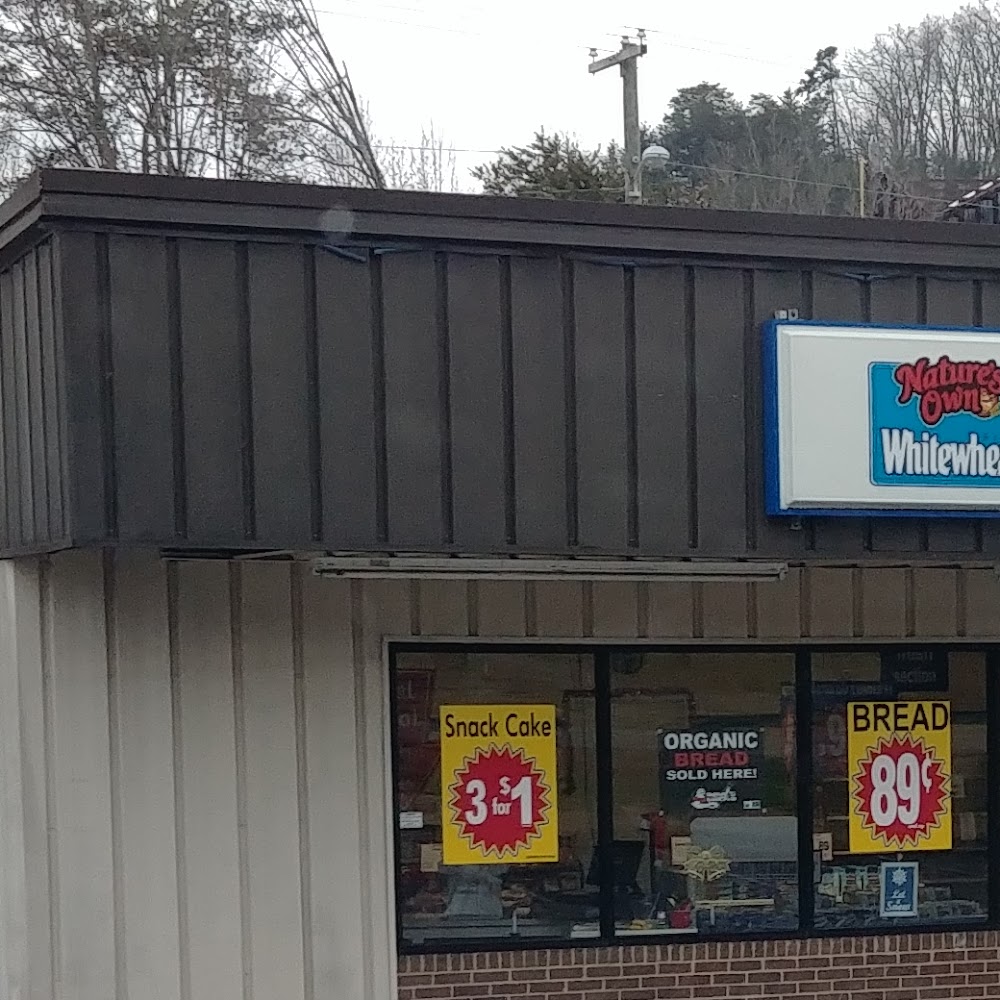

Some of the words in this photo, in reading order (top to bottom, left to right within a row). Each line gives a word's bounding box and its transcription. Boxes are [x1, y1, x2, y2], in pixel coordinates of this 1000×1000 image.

[919, 387, 981, 425] Own
[445, 713, 499, 738] Snack
[505, 713, 551, 737] Cake
[853, 703, 949, 732] BREAD
[663, 731, 759, 750] ORGANIC
[673, 752, 749, 768] BREAD
[666, 769, 708, 781] SOLD
[711, 768, 758, 780] HERE!
[465, 779, 488, 825] 3
[491, 796, 511, 816] for
